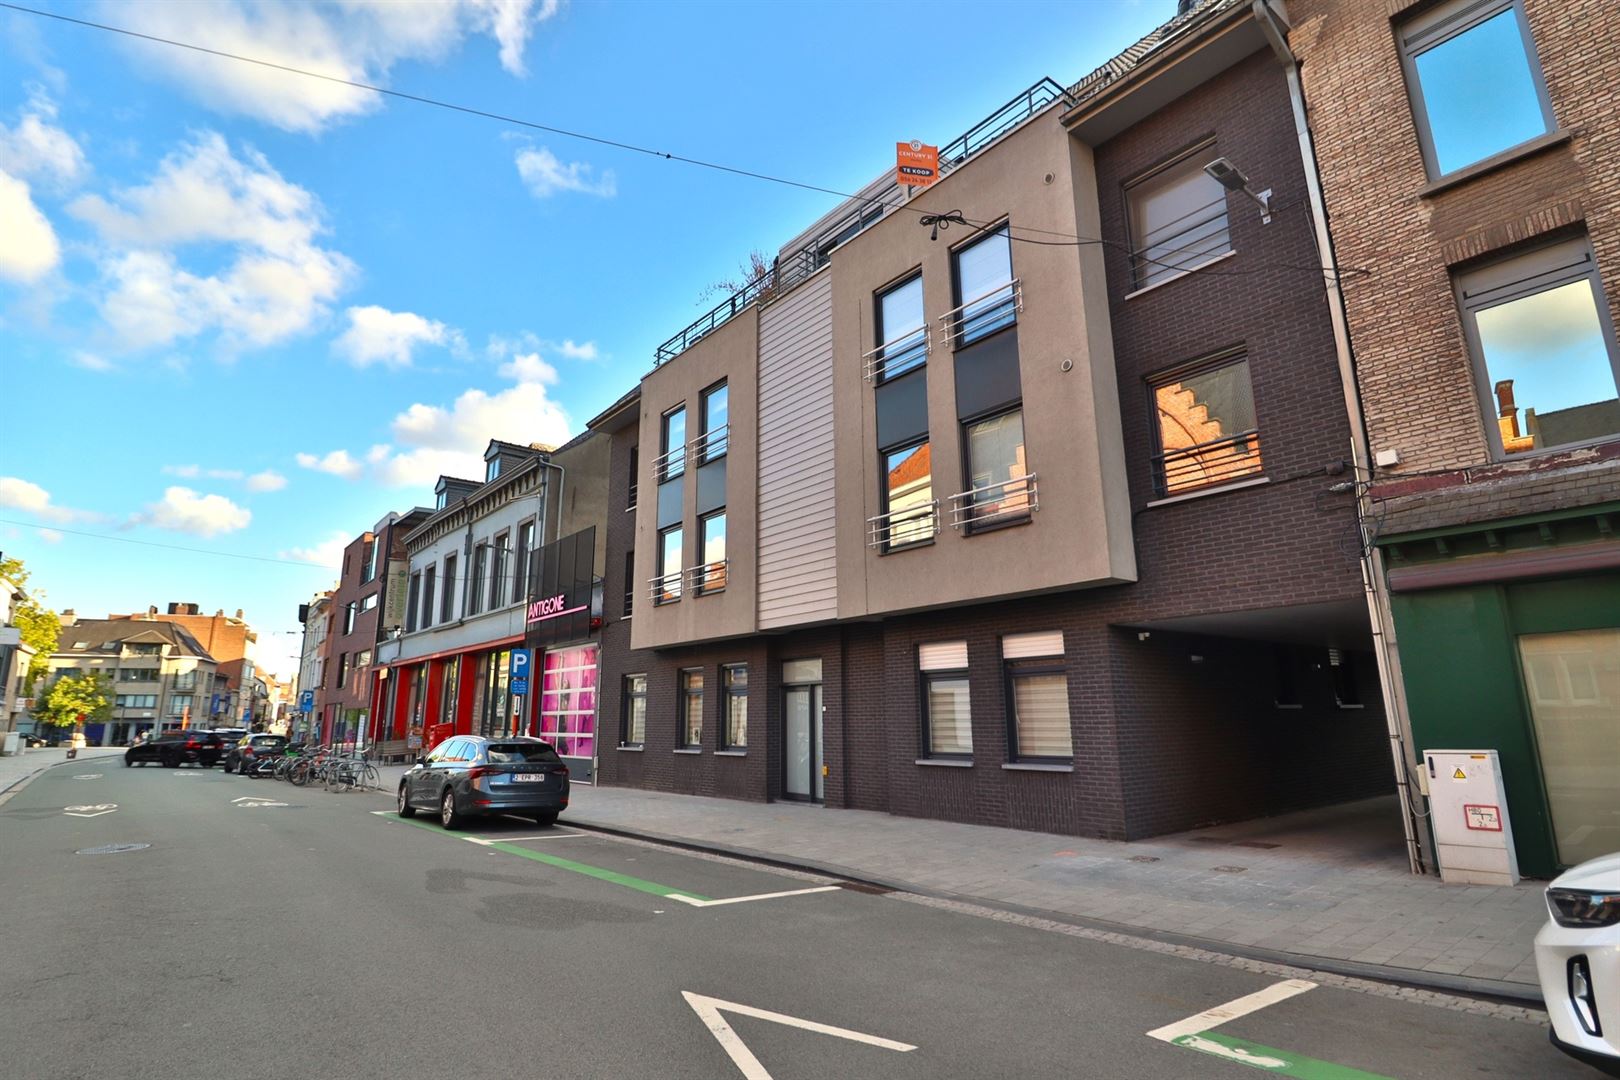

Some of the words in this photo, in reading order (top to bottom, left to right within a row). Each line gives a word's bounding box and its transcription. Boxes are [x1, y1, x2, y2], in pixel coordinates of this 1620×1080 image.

[899, 151, 926, 159] CENTURY
[528, 594, 565, 619] ANTIGONE
[513, 653, 527, 673] P
[304, 693, 312, 703] P
